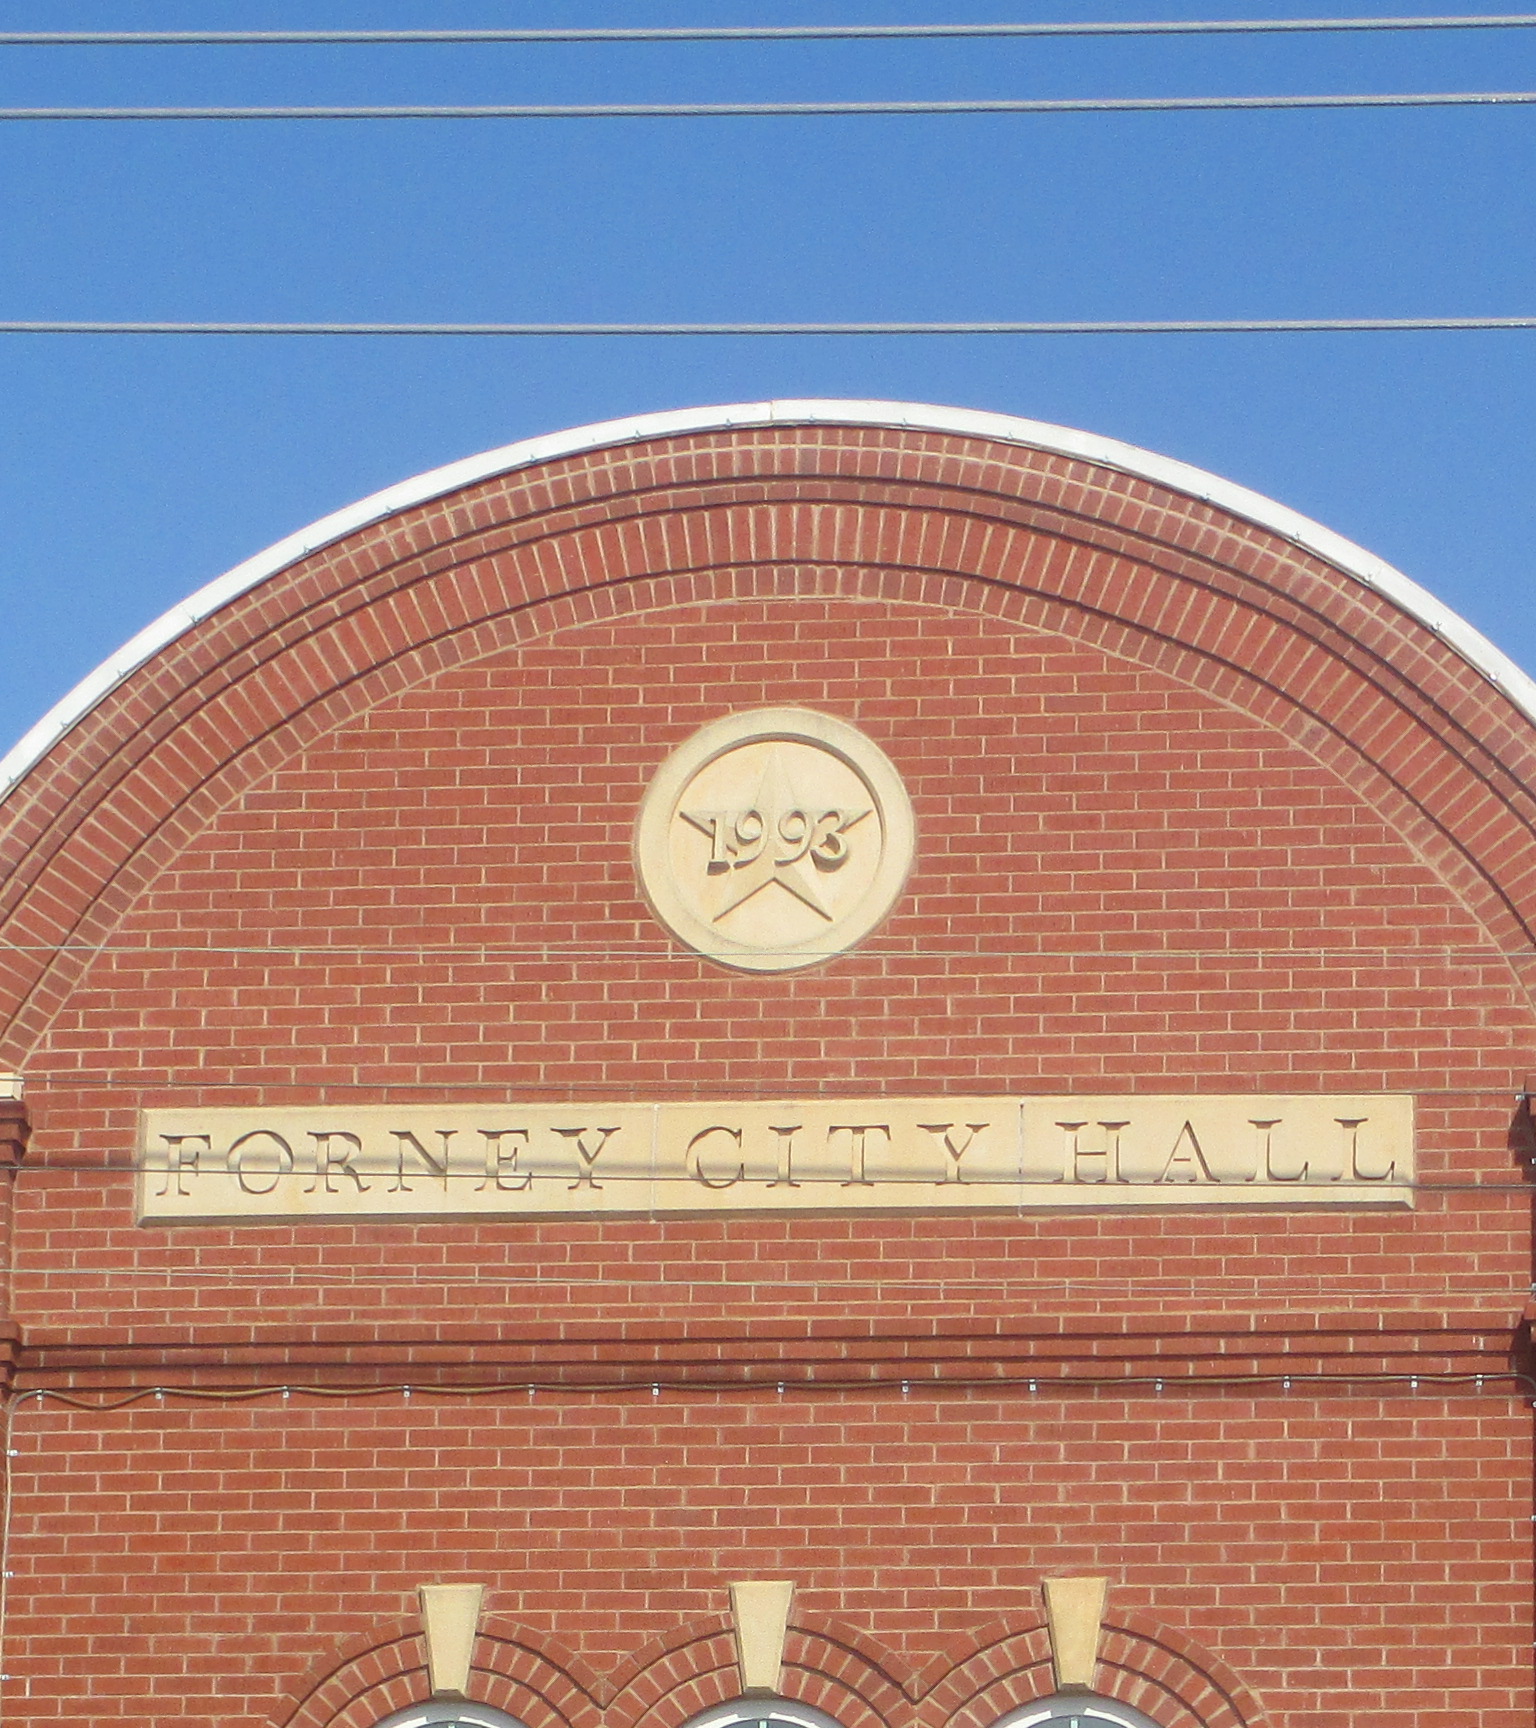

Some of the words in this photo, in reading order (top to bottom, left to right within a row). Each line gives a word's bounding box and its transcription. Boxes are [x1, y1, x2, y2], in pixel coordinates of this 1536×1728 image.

[706, 809, 850, 876] 1993
[155, 1126, 622, 1197] FORNEY
[685, 1122, 990, 1190] CITY
[1052, 1117, 1396, 1184] HALL
